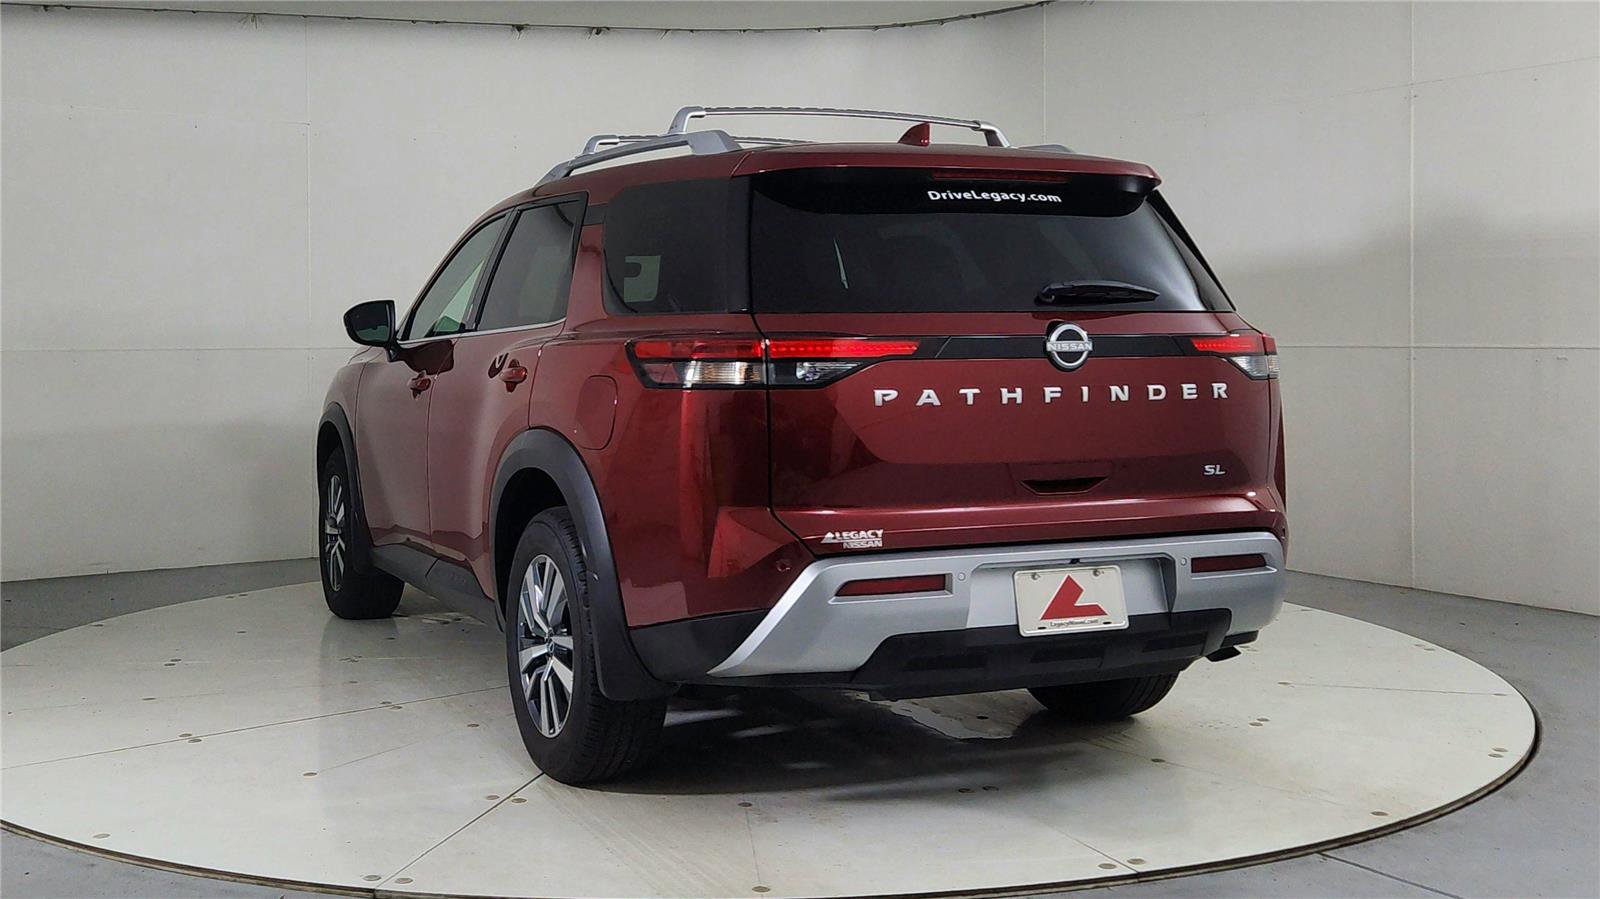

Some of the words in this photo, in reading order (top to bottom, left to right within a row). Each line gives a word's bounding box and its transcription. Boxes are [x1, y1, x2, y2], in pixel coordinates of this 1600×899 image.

[927, 190, 1062, 202] DriveLegacy.com
[1046, 341, 1093, 351] NISSAN
[873, 382, 1229, 406] PATHFINDER
[1203, 464, 1226, 475] SL
[834, 529, 883, 540] LEGACY
[842, 540, 883, 549] NISSAN
